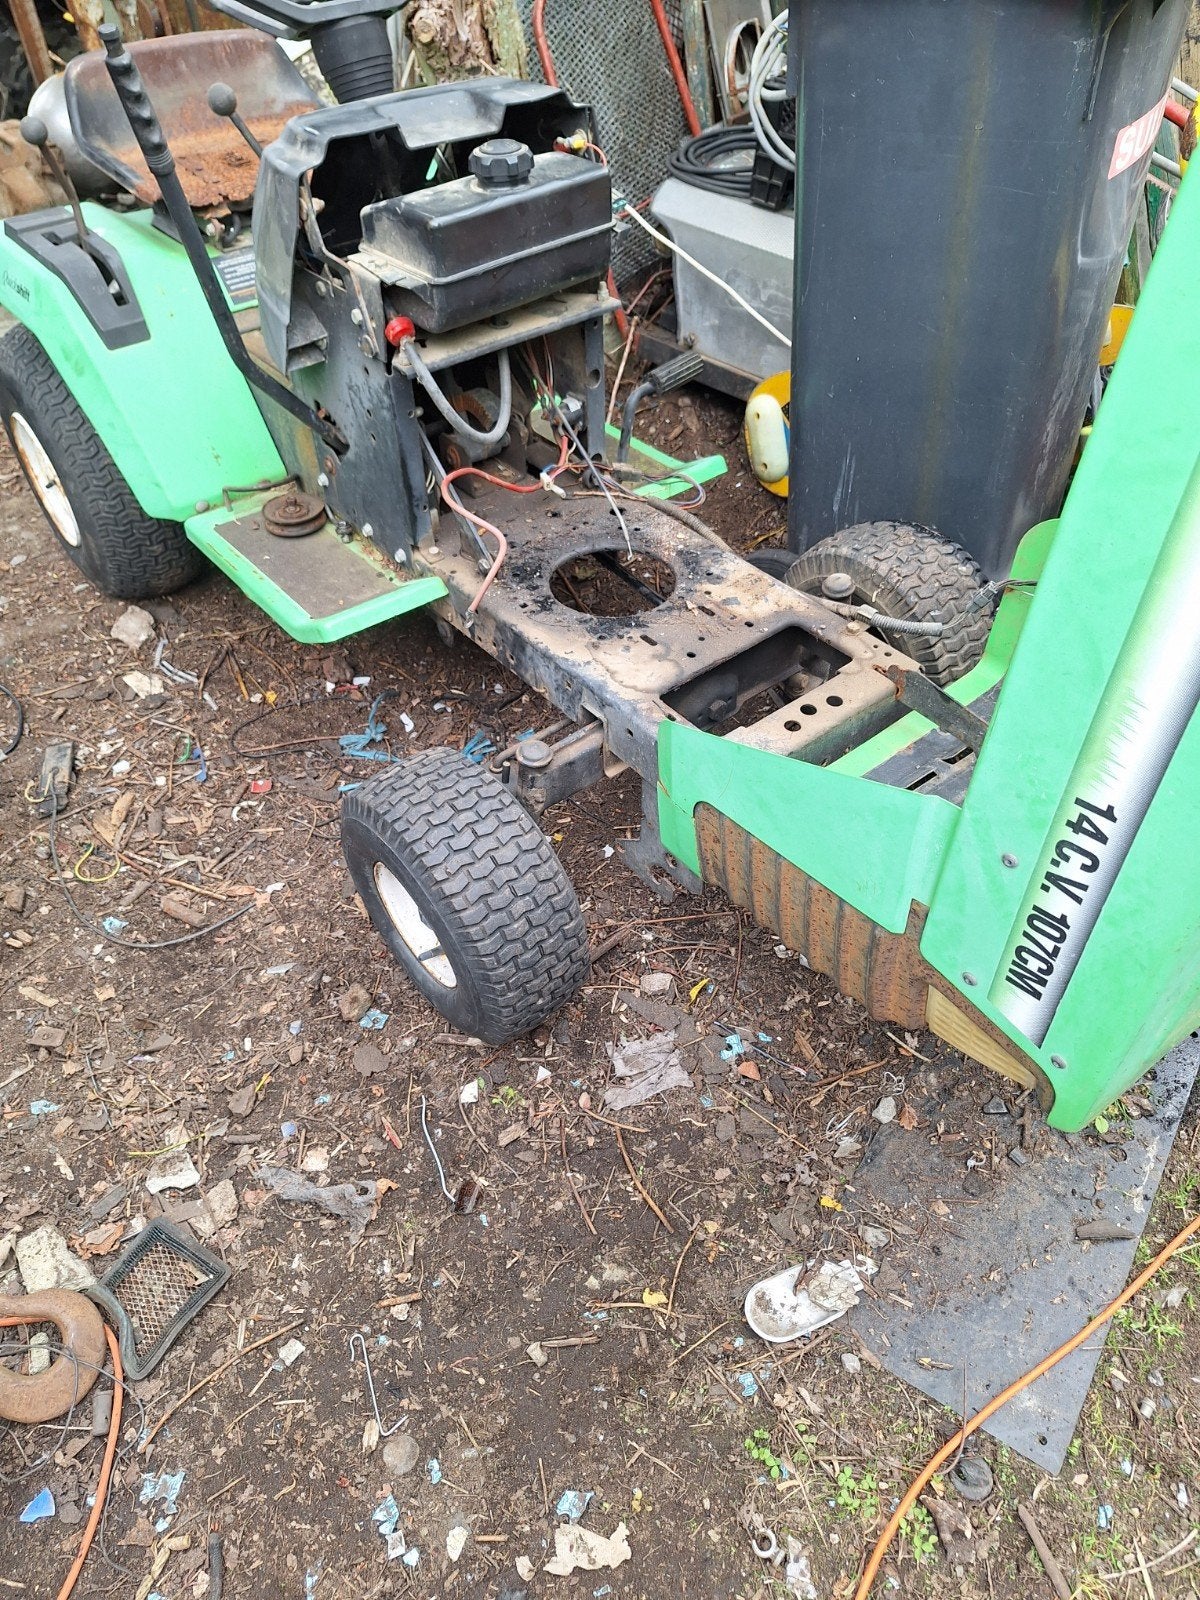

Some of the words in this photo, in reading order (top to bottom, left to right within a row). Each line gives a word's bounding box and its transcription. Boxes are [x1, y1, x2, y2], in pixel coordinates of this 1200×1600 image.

[1065, 797, 1118, 845] 14
[1040, 839, 1100, 905] C.V.
[1005, 904, 1071, 1001] 107CM
